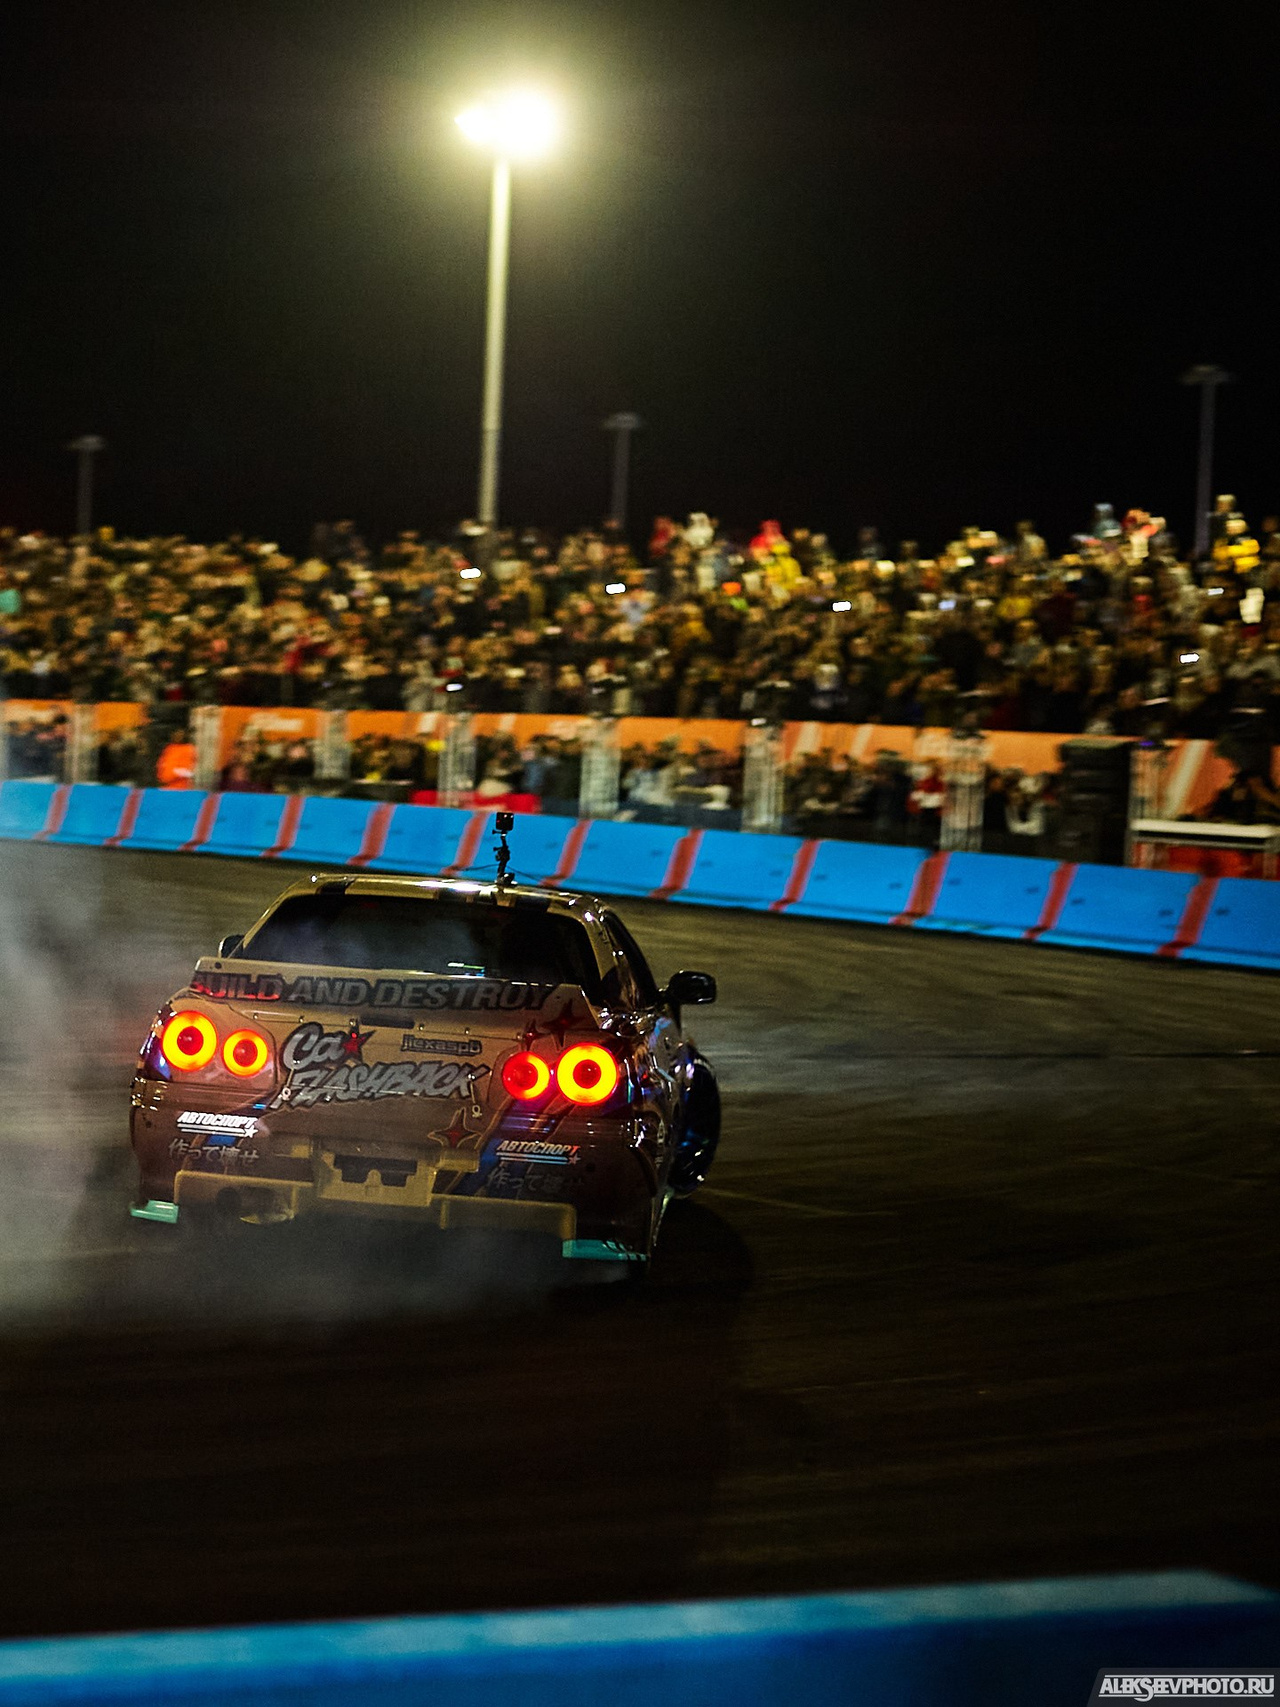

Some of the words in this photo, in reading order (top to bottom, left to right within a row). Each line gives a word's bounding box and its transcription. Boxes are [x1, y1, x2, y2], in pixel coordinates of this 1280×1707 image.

[287, 977, 368, 1005] AND
[371, 980, 547, 1010] DESTROY
[177, 1111, 258, 1129] АВТОСПОРТ
[496, 1140, 580, 1156] АВТОСПОРТ
